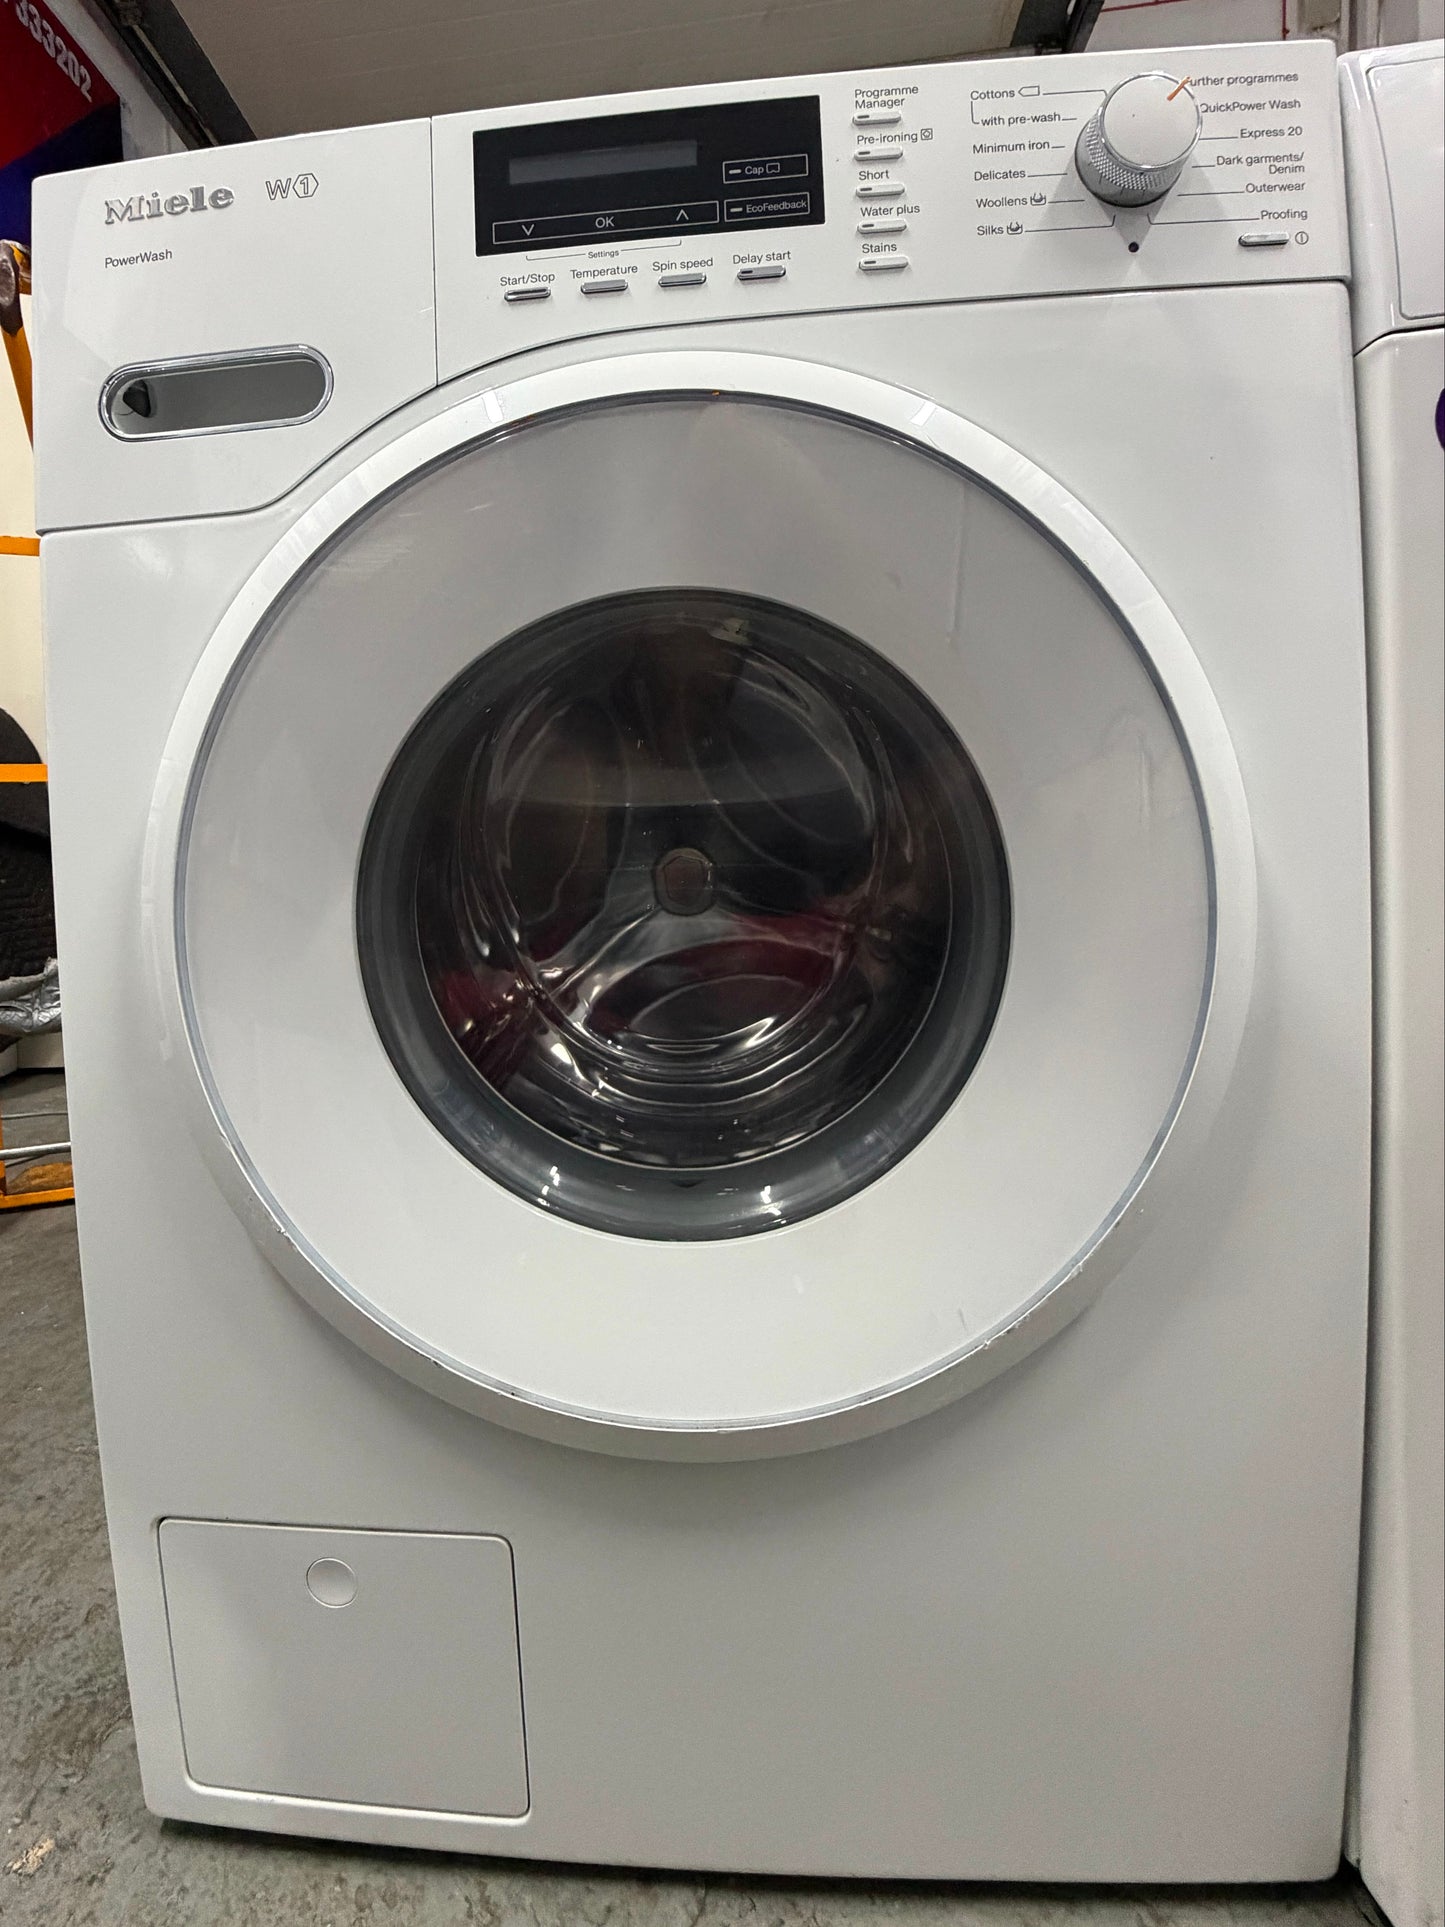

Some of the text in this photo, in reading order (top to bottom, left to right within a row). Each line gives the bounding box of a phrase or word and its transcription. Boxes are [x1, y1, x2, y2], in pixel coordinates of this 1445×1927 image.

[1188, 73, 1298, 87] urther programmes
[854, 86, 919, 99] Programme
[970, 90, 1016, 101] Cottons
[855, 98, 905, 109] Manager
[1200, 99, 1301, 113] QuickPower Wash
[981, 112, 1061, 127] with pre-wash
[857, 132, 918, 144] Pre-ironing
[1240, 126, 1303, 140] Express 20
[973, 141, 1050, 154] Minimum iron
[1216, 152, 1305, 166] Dark garments/
[744, 165, 765, 175] Cap
[858, 169, 890, 181] Short
[974, 169, 1026, 181] Delicates
[1268, 164, 1305, 175] Denim
[1245, 182, 1306, 193] Outerwear
[104, 185, 235, 225] Miele
[746, 200, 807, 214] EcoFeedback
[975, 196, 1028, 208] Woollens
[860, 204, 921, 217] Water plus
[1260, 209, 1308, 221] Proofing
[595, 216, 615, 229] OK
[976, 225, 1004, 236] Silks
[587, 249, 619, 259] Settings
[861, 242, 898, 254] Stains
[104, 248, 173, 268] PowerWash
[732, 250, 792, 265] Delay start
[652, 257, 714, 273] Spin speed
[570, 264, 639, 280] Temperature
[499, 273, 556, 287] Start/Stop
